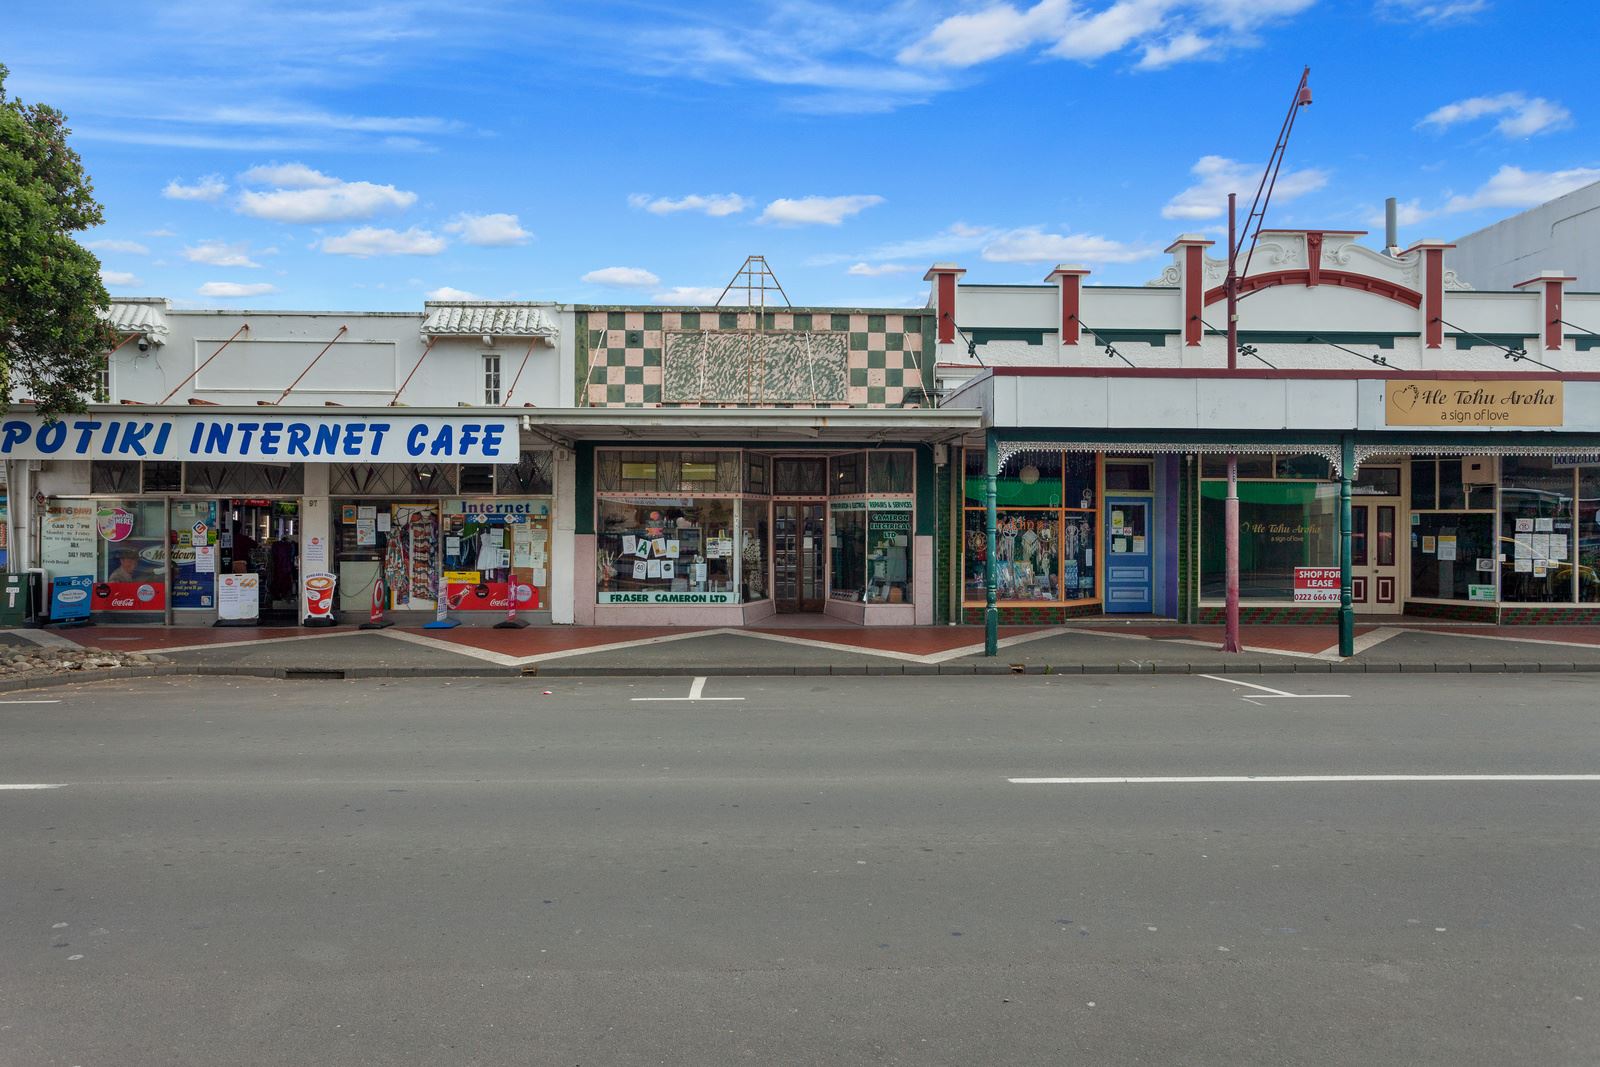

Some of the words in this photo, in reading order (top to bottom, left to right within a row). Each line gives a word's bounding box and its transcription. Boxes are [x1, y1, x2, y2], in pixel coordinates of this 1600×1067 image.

[1422, 389, 1447, 405] He
[1453, 388, 1494, 405] Tohu
[1501, 388, 1555, 405] Aroha
[1441, 412, 1447, 420] a
[1449, 410, 1471, 422] sign
[1474, 409, 1487, 420] of
[1487, 409, 1509, 420] love
[1, 420, 172, 456] POTIKI
[189, 421, 391, 457] INTERNET
[406, 423, 505, 457] CAFE
[461, 501, 531, 513] Internet
[870, 522, 911, 530] ELECTRICAL
[1299, 570, 1322, 578] SHOP
[1324, 570, 1341, 578] FOR
[1307, 579, 1334, 587] LEASE
[610, 594, 649, 603] FRASER
[655, 593, 707, 603] CAMERON
[709, 594, 727, 603] LTD
